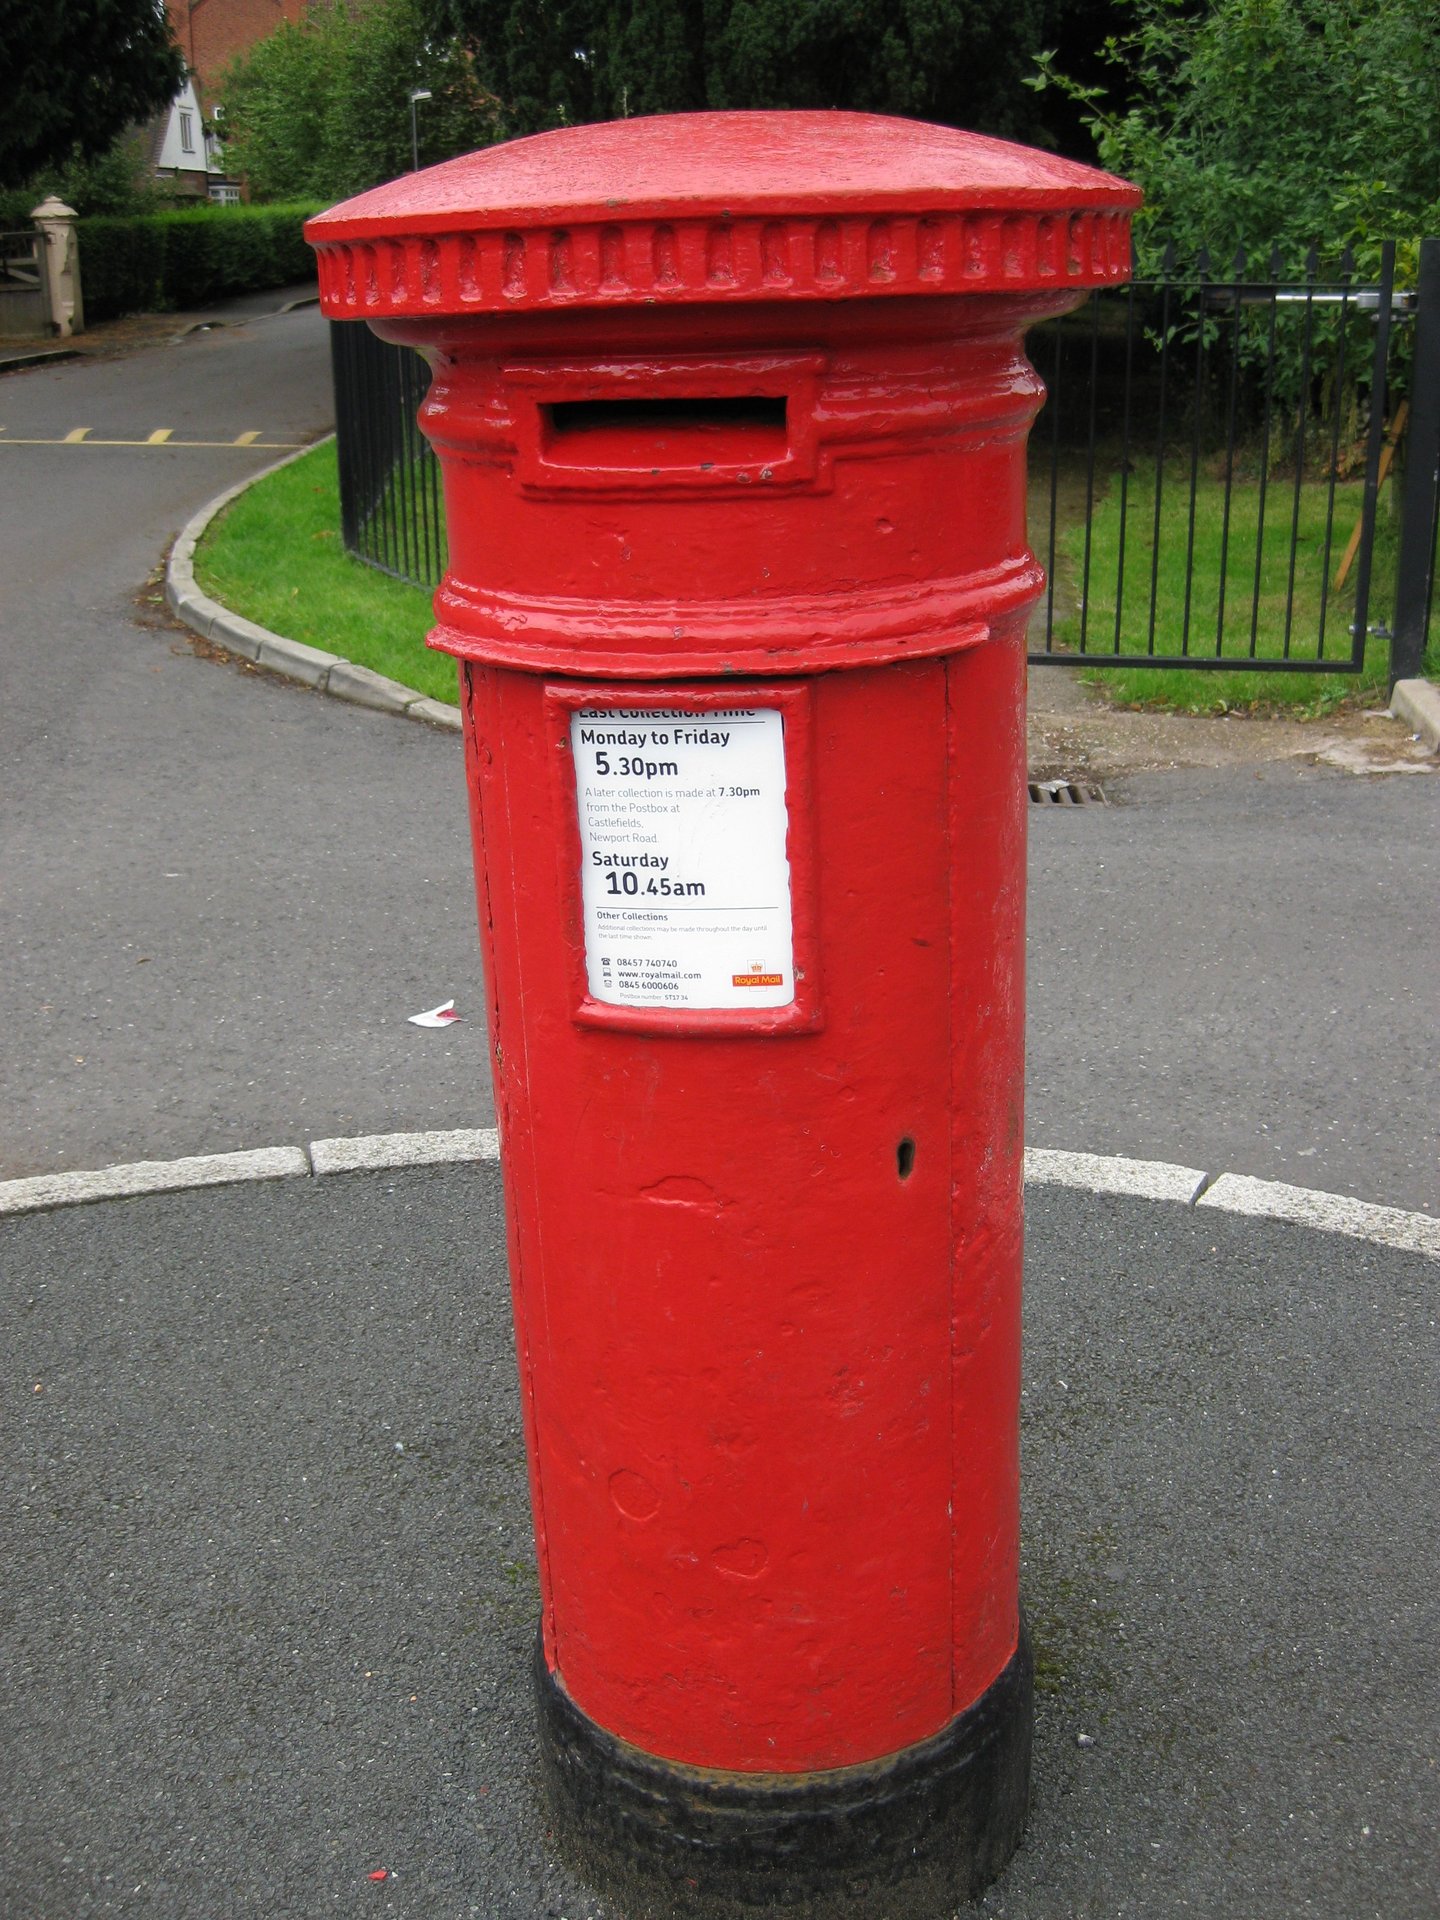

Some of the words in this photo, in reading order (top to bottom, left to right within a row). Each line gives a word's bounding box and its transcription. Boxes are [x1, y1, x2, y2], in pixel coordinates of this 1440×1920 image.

[580, 729, 647, 748] Monday
[651, 731, 669, 745] to
[674, 729, 730, 747] Friday
[595, 751, 678, 779] 5.30pm
[585, 787, 592, 797] A
[593, 787, 615, 797] later
[618, 788, 663, 798] collection
[665, 788, 673, 798] is
[675, 788, 704, 798] made
[706, 788, 716, 798] at
[718, 786, 760, 798] 7.30pm
[586, 802, 610, 812] from
[611, 803, 627, 813] the
[629, 803, 668, 813] Postbox
[670, 804, 680, 813] at
[588, 816, 644, 829] Castlefields,
[589, 832, 630, 844] Newport
[592, 851, 669, 871] Saturday
[605, 871, 706, 896] 10.45am
[596, 911, 620, 920] Other
[622, 912, 669, 921] Collections
[616, 958, 643, 967] 08457
[645, 959, 678, 968] 740740
[617, 970, 702, 980] www.royalmail.com
[734, 975, 760, 986] Royal
[761, 975, 781, 984] Mail
[618, 980, 640, 989] 0845
[641, 981, 679, 990] 6000606
